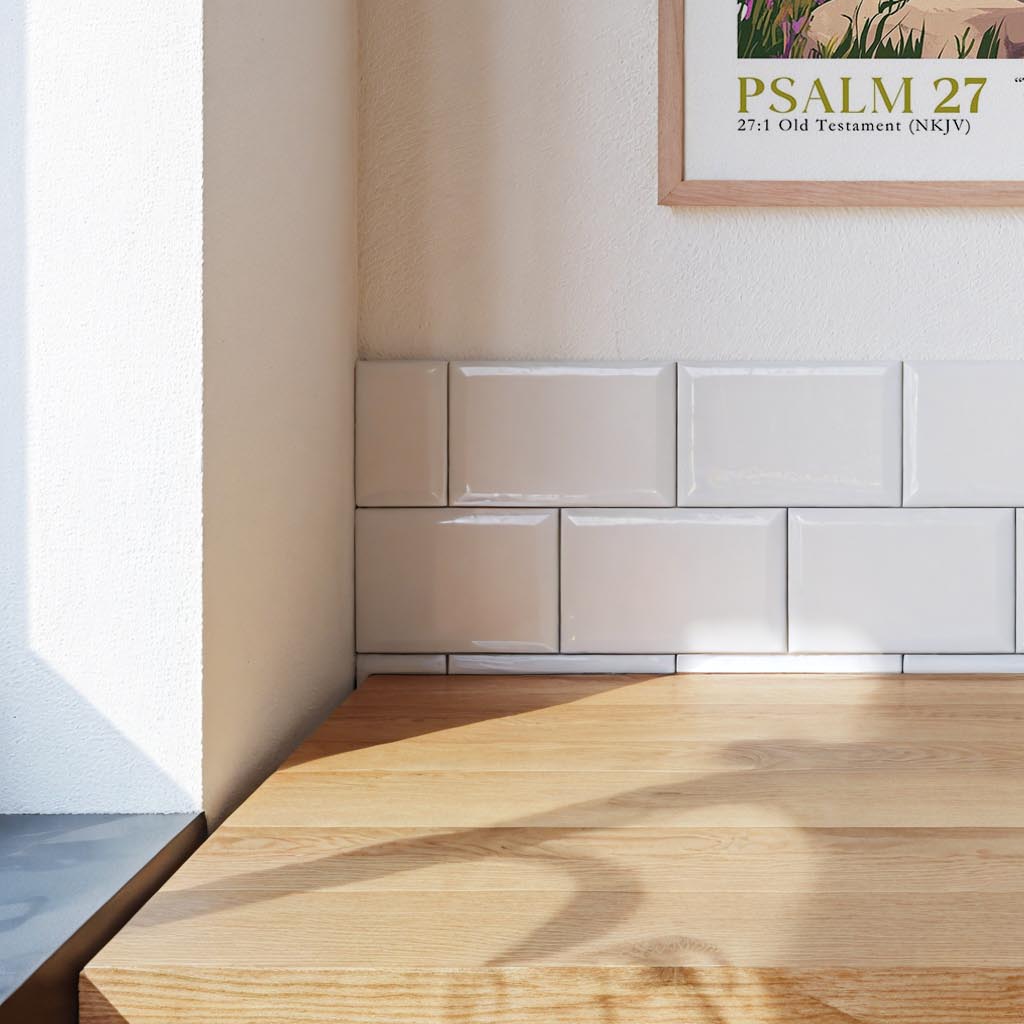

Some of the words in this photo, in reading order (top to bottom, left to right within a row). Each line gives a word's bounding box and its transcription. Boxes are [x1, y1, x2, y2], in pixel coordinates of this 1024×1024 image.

[737, 76, 914, 114] PSALM
[932, 76, 988, 114] 27
[737, 119, 770, 131] 27:1
[778, 119, 809, 131] Old
[815, 119, 902, 131] Testament
[908, 119, 971, 135] (NKJV)
